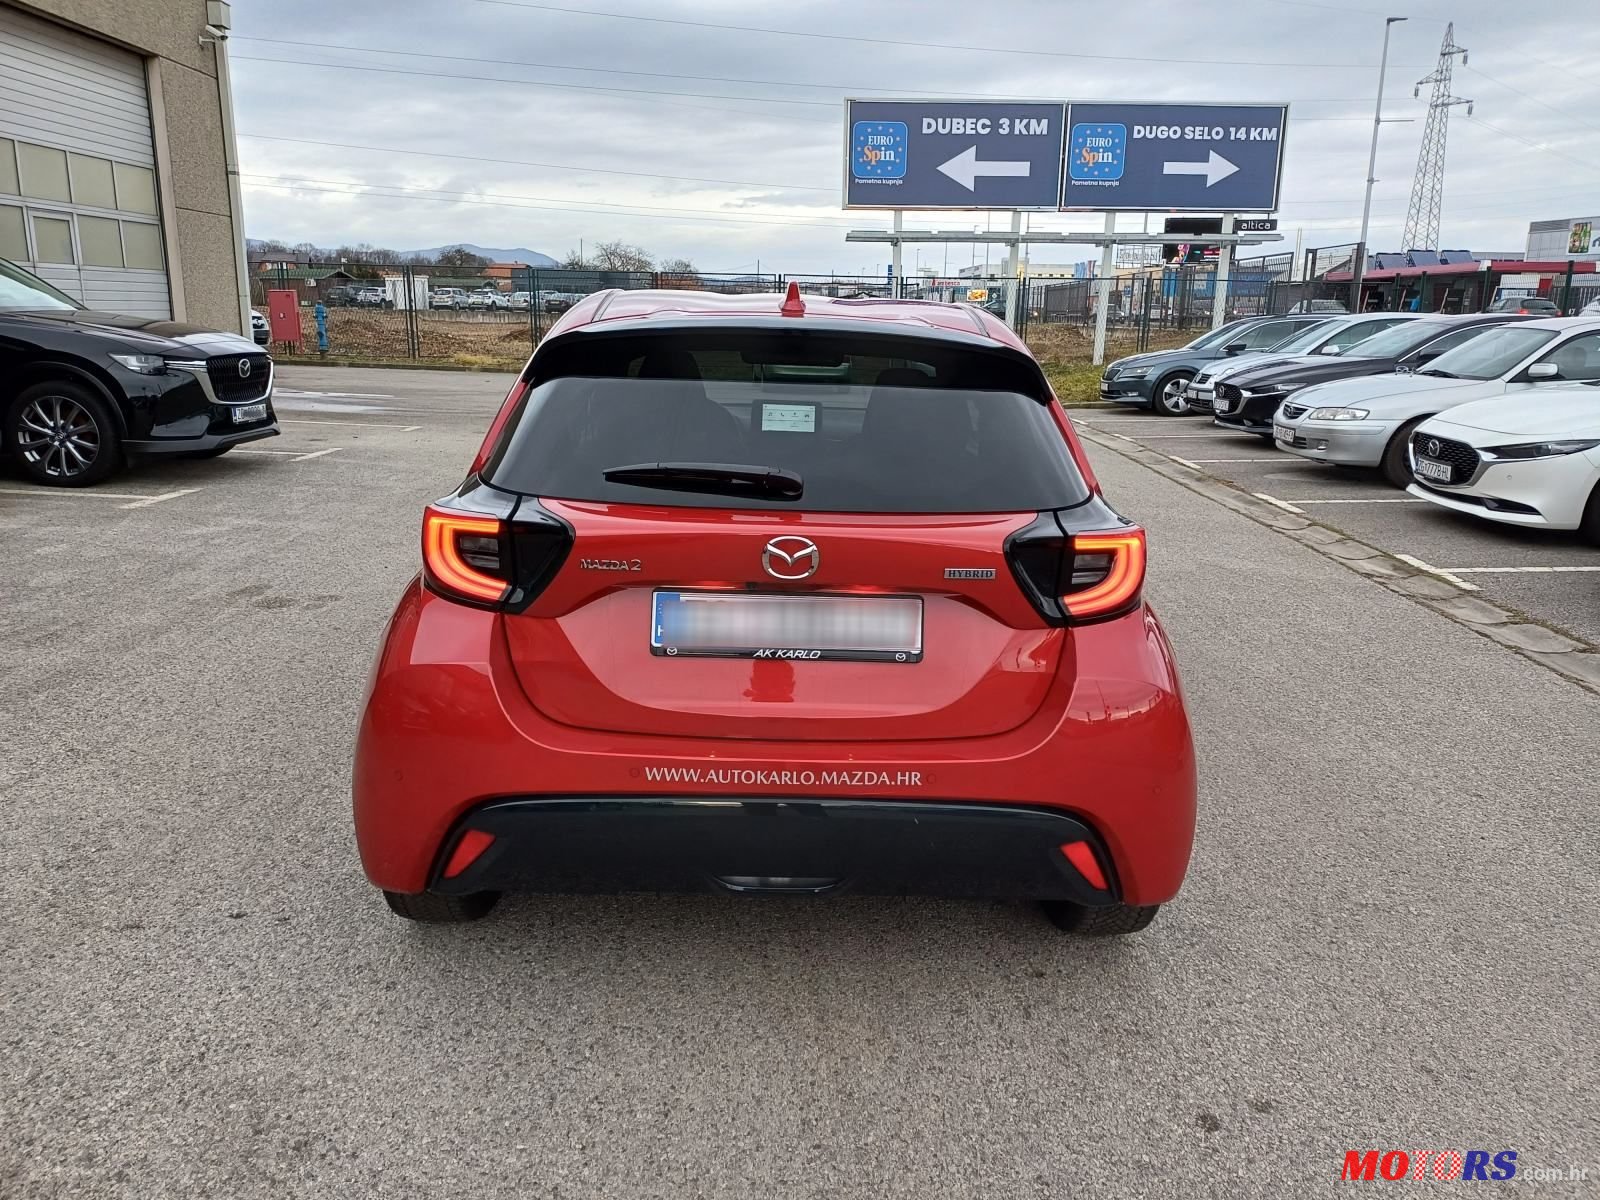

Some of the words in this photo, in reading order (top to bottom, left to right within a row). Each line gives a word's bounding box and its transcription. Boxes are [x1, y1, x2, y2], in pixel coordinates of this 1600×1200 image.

[922, 117, 991, 135] DUBEC
[998, 117, 1010, 135] 3
[1014, 118, 1048, 135] KM
[1133, 125, 1181, 139] DUGO
[1184, 126, 1224, 140] SELO
[1229, 127, 1247, 141] 14
[1250, 127, 1278, 141] KM
[868, 135, 893, 146] EURO
[1086, 137, 1112, 147] EURO
[863, 145, 895, 165] Spin
[1081, 147, 1113, 167] Spin
[882, 178, 903, 186] kupnja
[1241, 220, 1271, 230] altica
[948, 569, 993, 578] HYBRID
[752, 649, 775, 658] AK
[775, 649, 821, 659] KARLO
[644, 766, 922, 786] WWW.AUTOKARLO.MAZDA.HR
